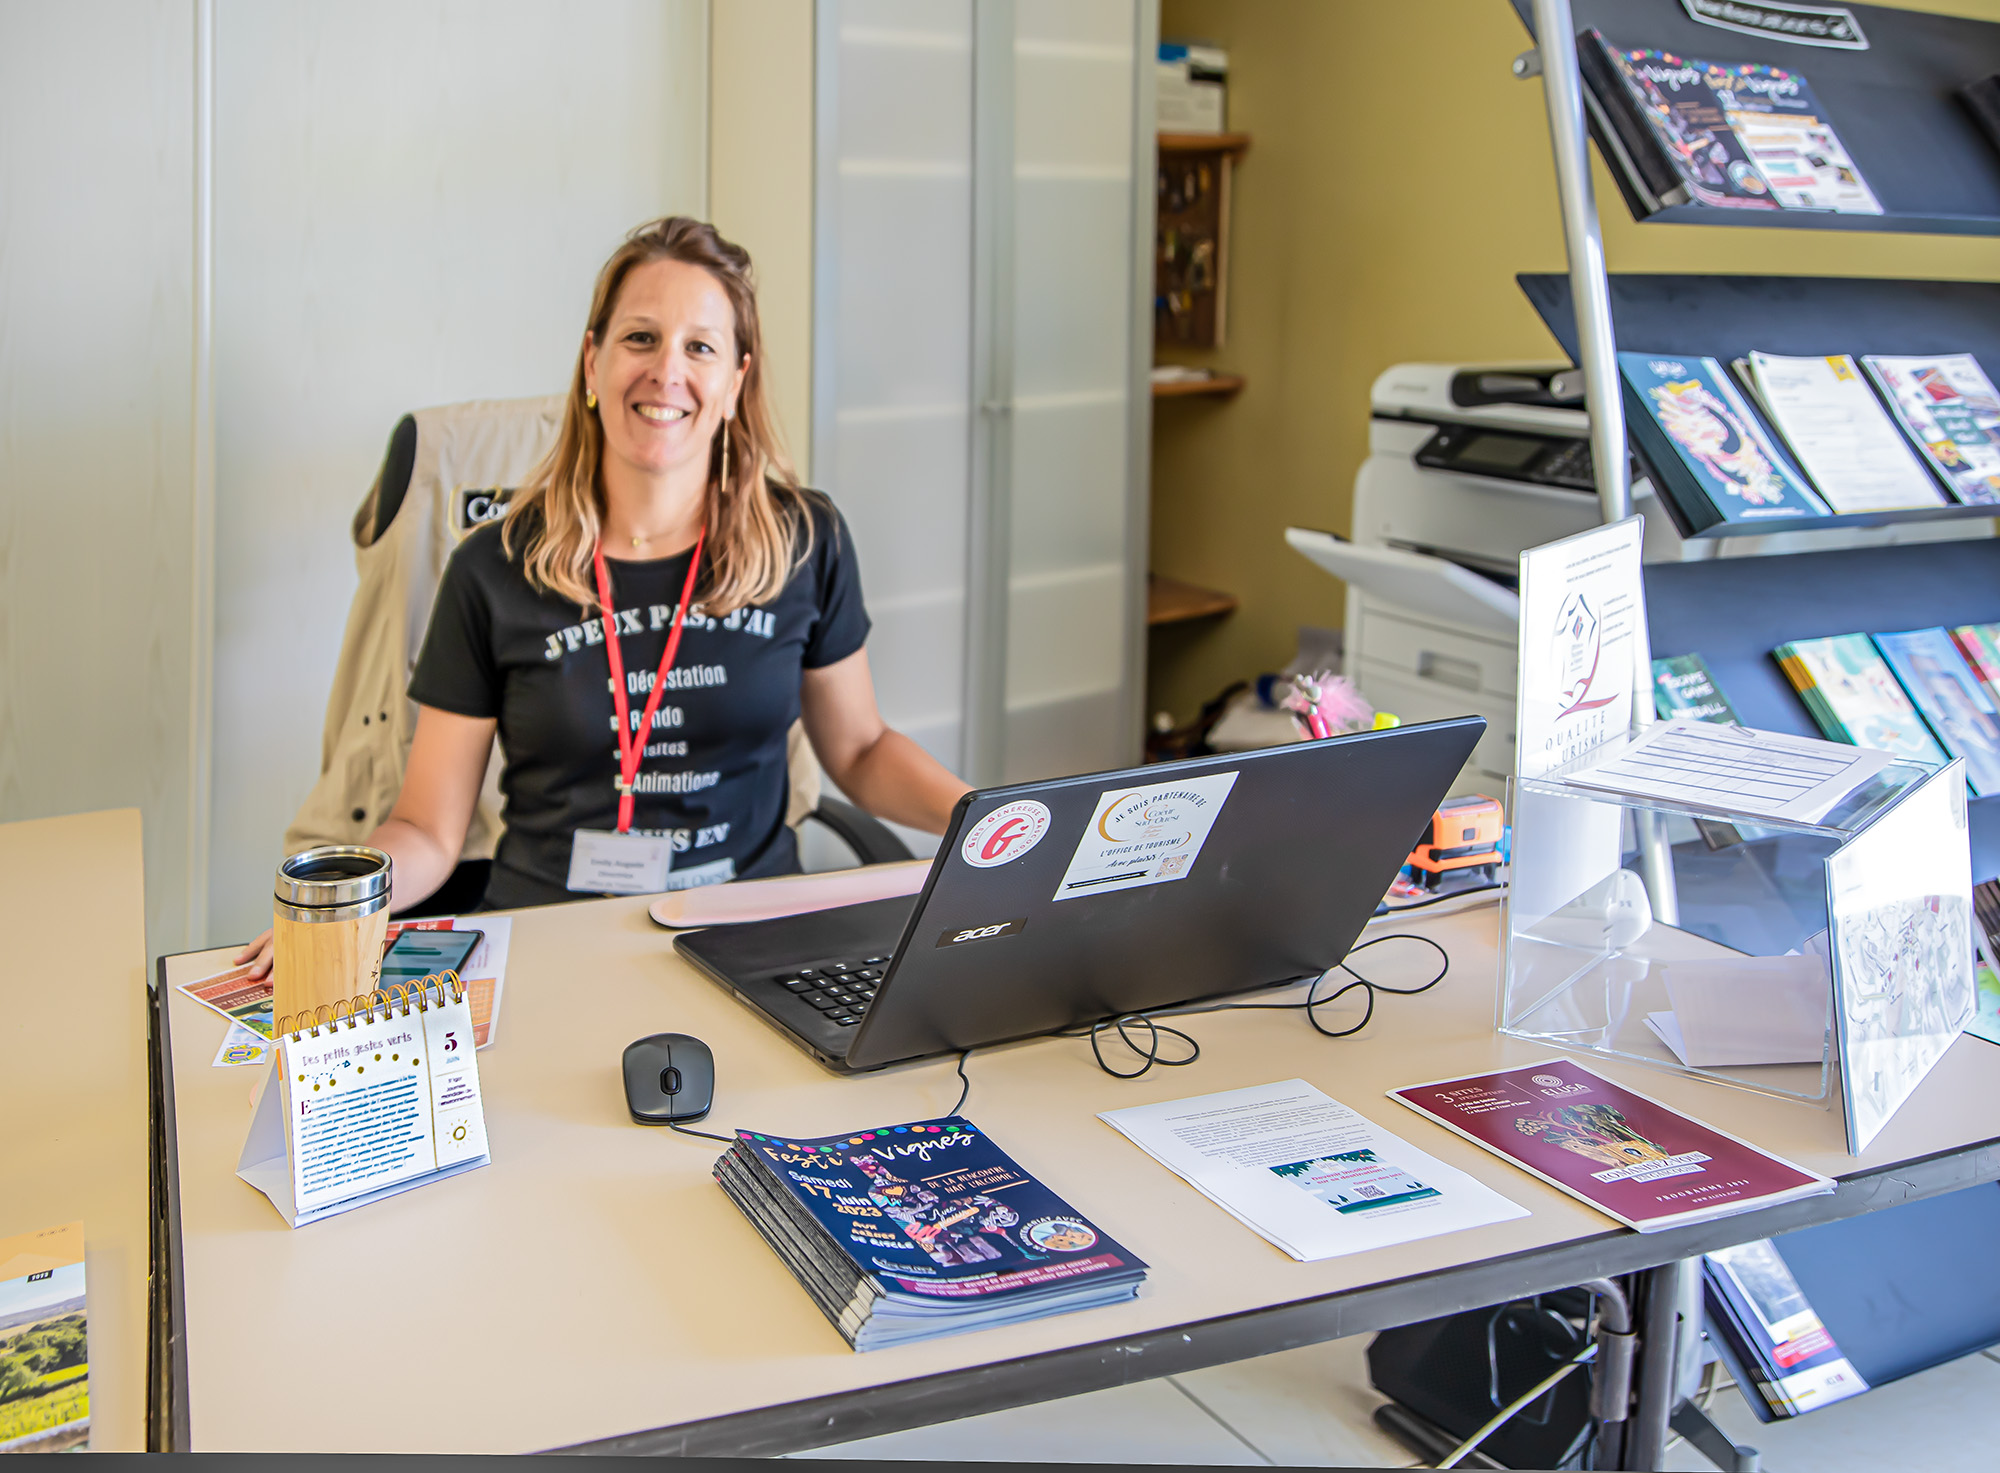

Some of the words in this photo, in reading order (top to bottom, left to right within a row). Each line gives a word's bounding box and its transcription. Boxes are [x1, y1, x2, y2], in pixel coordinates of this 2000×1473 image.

[629, 705, 684, 731] Rndo
[642, 740, 688, 757] isites
[1545, 729, 1605, 772] URISME
[631, 770, 721, 793] Animations
[1127, 799, 1149, 815] SUIS
[1100, 846, 1132, 858] L'OFFICE
[1134, 843, 1144, 852] DE
[1145, 838, 1182, 850] TOURISME
[952, 922, 1012, 943] acer
[302, 1054, 320, 1067] Des
[323, 1046, 351, 1065] petits
[354, 1040, 384, 1057] gestes
[387, 1031, 412, 1046] verts
[444, 1031, 458, 1052] 5
[1435, 1092, 1455, 1104] 3
[1540, 1082, 1590, 1096] ELUSA
[762, 1146, 844, 1170] Festi'
[870, 1131, 975, 1162] Vignes
[800, 1182, 832, 1199] 17
[942, 1176, 957, 1186] LA
[831, 1202, 883, 1218] 2023
